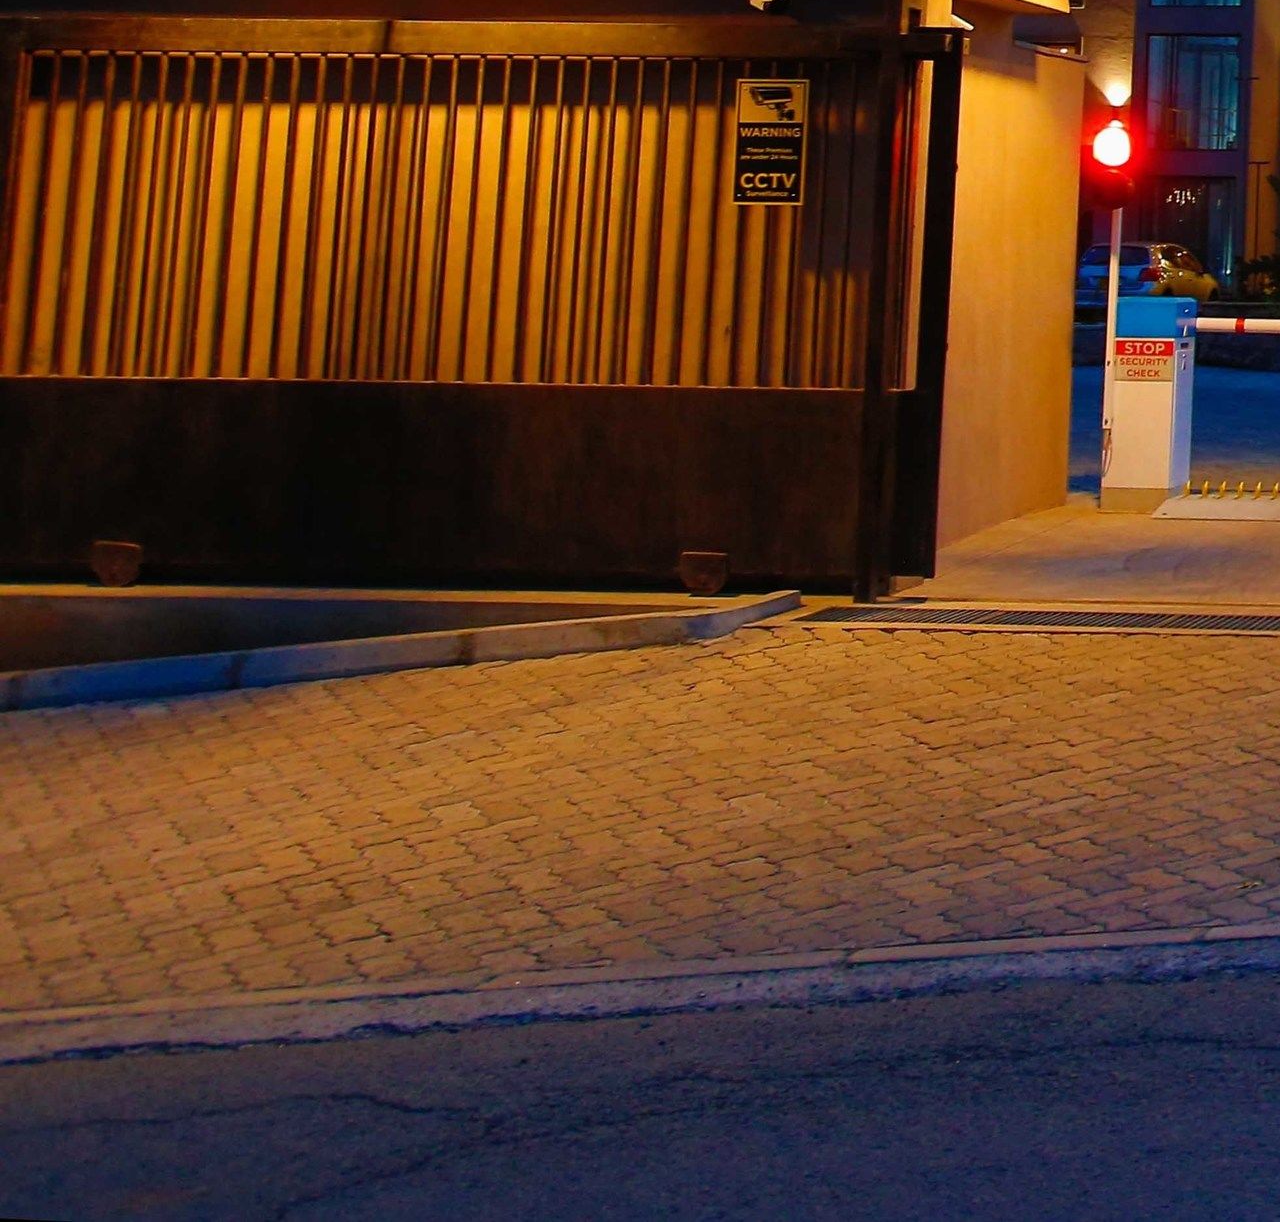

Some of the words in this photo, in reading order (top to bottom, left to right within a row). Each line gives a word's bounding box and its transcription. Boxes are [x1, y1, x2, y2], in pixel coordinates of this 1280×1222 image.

[740, 127, 801, 137] WARNING
[740, 173, 796, 188] CCTV
[1124, 342, 1165, 354] STOP
[1120, 358, 1168, 366] SECURITY
[1126, 369, 1160, 377] CHECK
